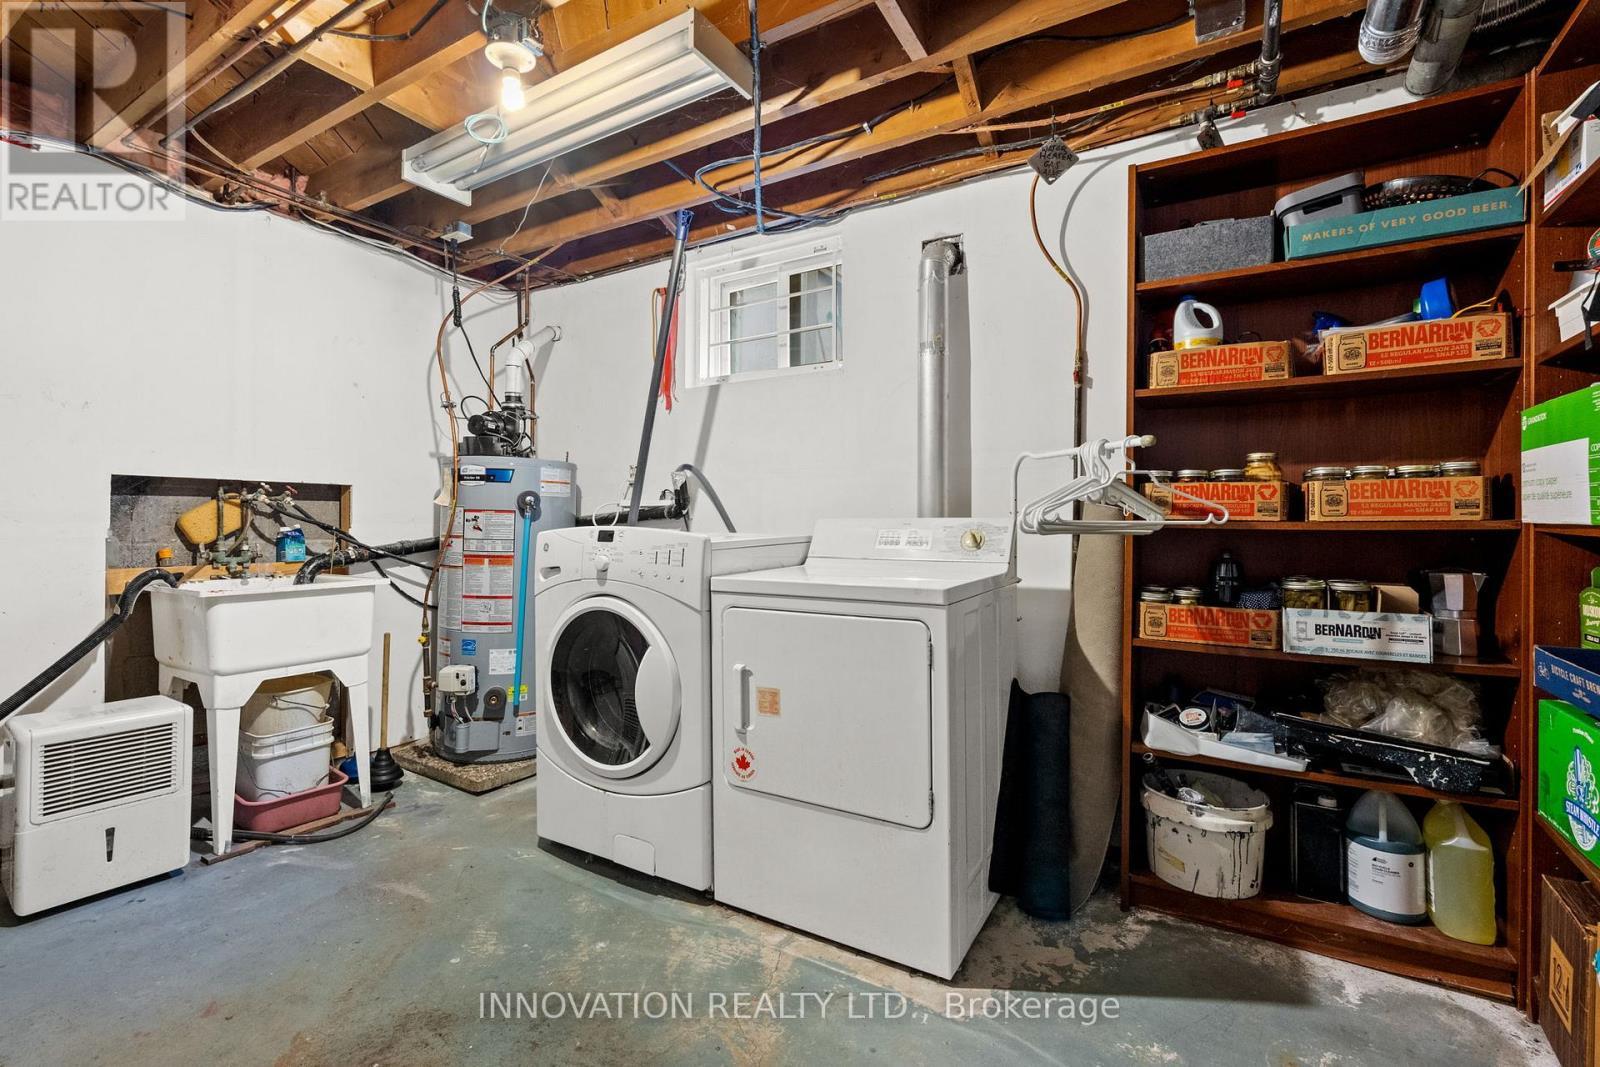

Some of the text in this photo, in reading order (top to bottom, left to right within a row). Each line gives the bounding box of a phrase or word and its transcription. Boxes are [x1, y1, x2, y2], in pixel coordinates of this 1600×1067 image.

[1302, 200, 1513, 242] MAKERS OF VERY GOOD BEER.
[1368, 320, 1473, 350] BERNARDIN
[1181, 346, 1264, 370] BERNARDIN
[1174, 482, 1255, 502] BERNARDIN
[1350, 480, 1450, 500] BERNARDIN
[1168, 607, 1250, 629] BERNARDIN
[1314, 623, 1382, 640] BERNARDIN
[1551, 664, 1569, 681] BICYCLE
[1569, 673, 1585, 688] CRAFT
[1566, 800, 1580, 819] STEAM
[1580, 809, 1600, 837] WHISTLE
